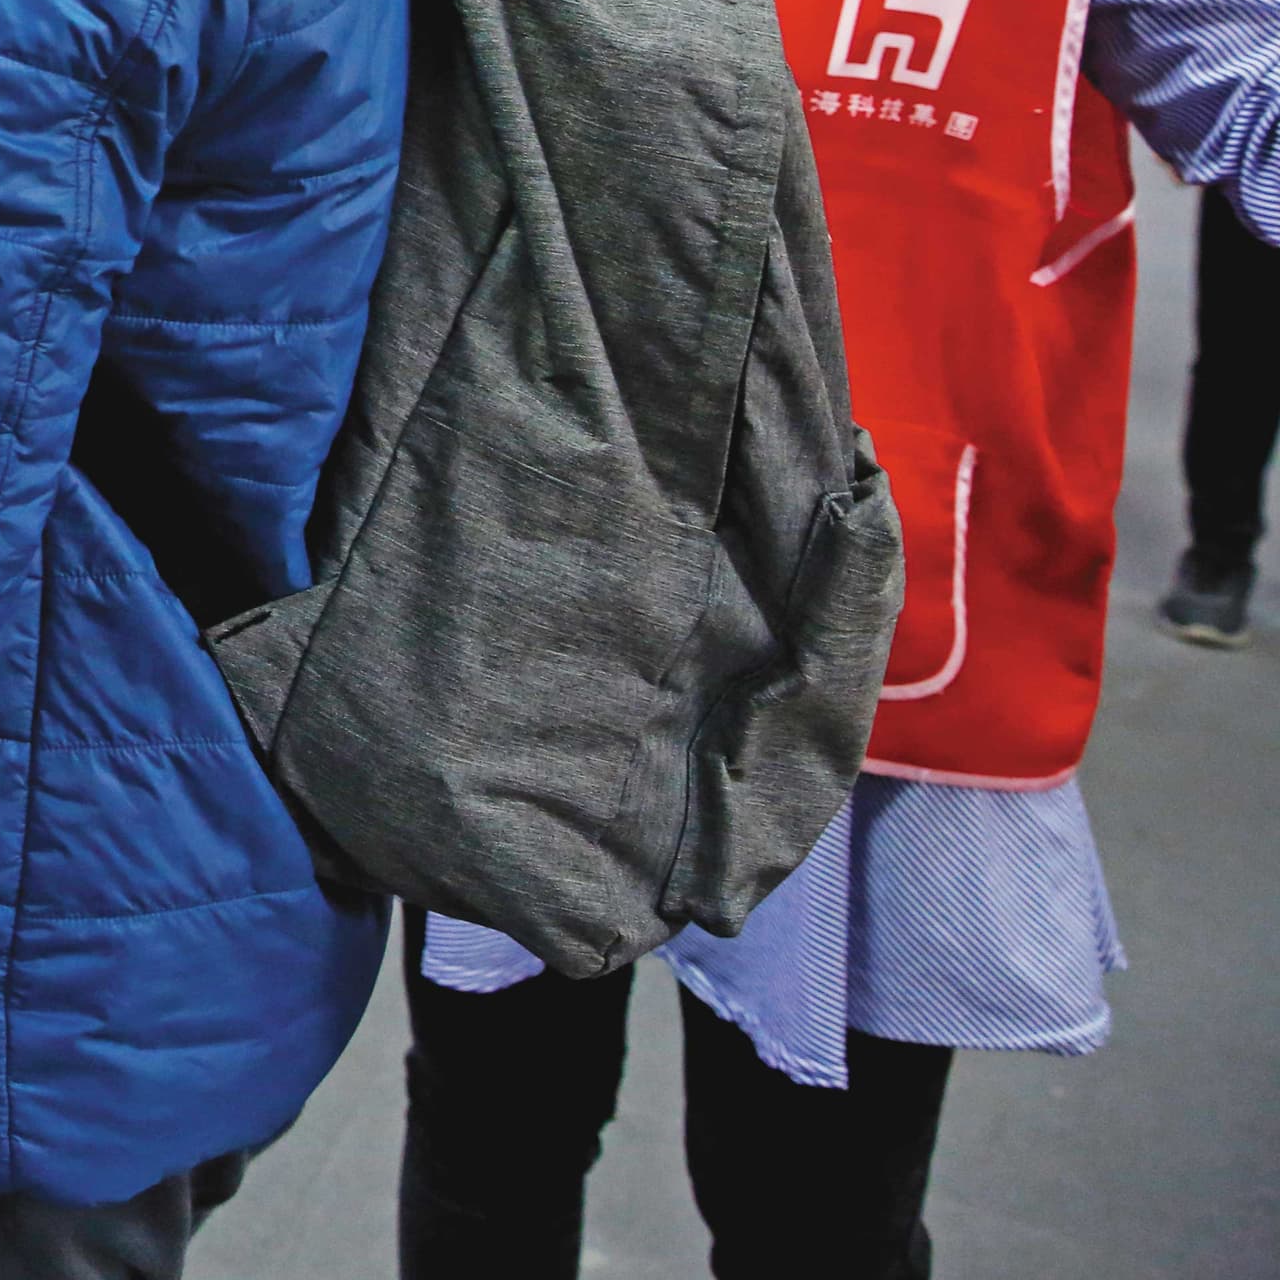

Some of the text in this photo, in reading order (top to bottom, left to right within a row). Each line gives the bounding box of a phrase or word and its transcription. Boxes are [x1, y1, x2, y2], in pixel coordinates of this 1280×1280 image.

[799, 88, 979, 141] 海科技集團
